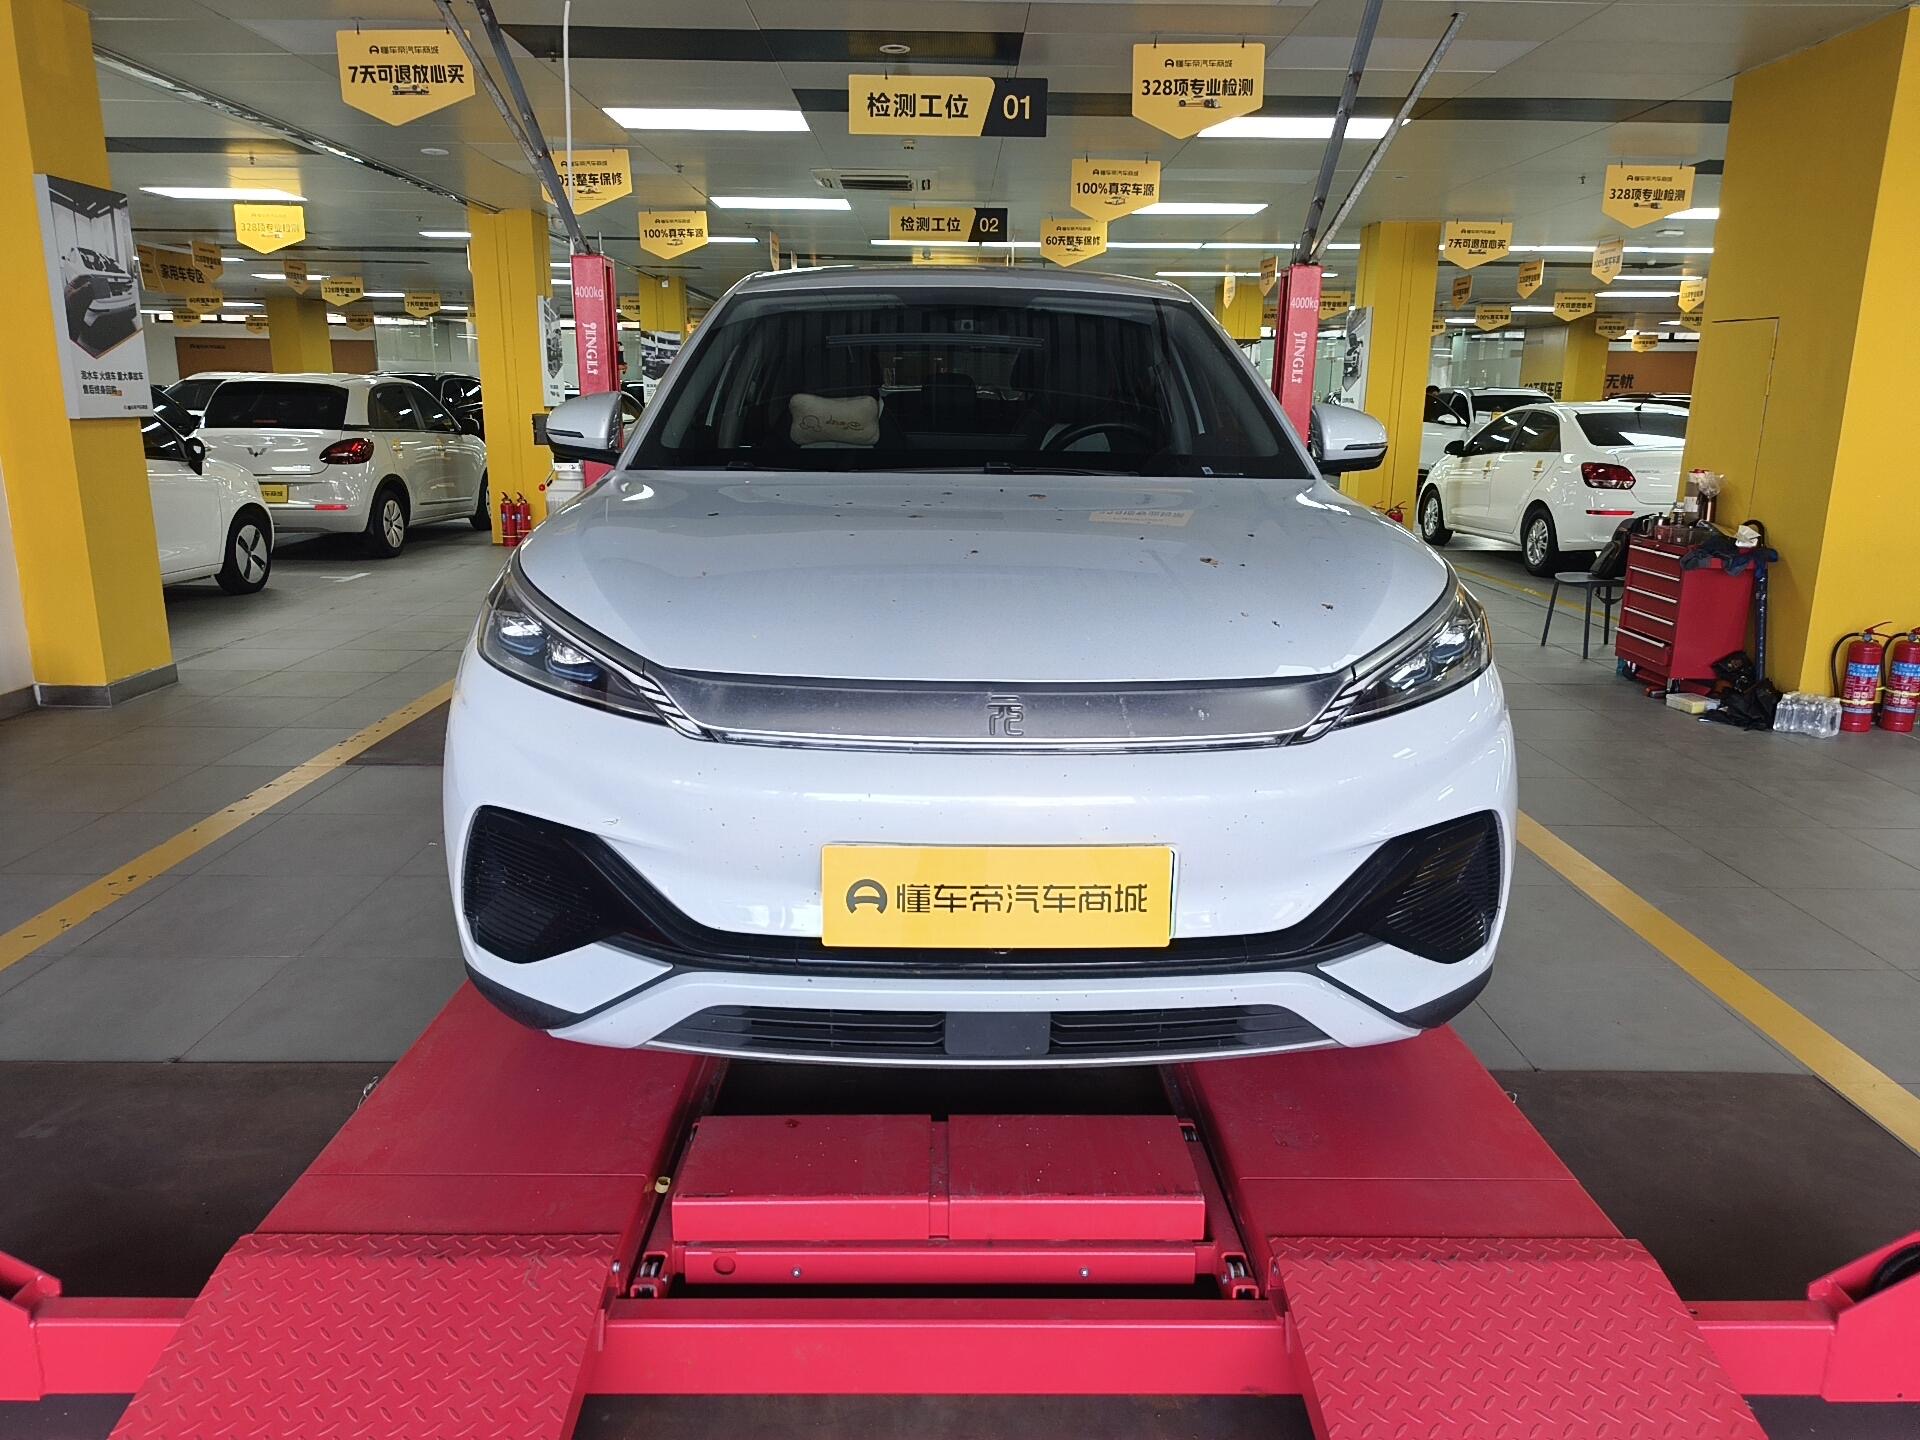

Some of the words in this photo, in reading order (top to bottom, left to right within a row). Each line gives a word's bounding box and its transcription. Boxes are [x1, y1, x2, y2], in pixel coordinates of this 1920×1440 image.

[348, 64, 465, 83] 7天可退放心买
[1141, 78, 1254, 98] 328项专业检测
[867, 92, 969, 119] 检测工位
[1003, 94, 1031, 120] 01
[1076, 182, 1155, 197] 100%真实车源
[1608, 188, 1686, 202] 328项专业检测
[900, 216, 961, 232] 检测工位
[979, 217, 999, 233] 02
[643, 228, 704, 238] 100%真实车源
[1045, 235, 1101, 246] 60天整车保修
[1448, 238, 1506, 249] 7天可退放心买
[160, 263, 206, 284] 家用车专区
[574, 286, 604, 301] 4000kg
[1290, 296, 1320, 312] 4000kg
[896, 883, 1148, 914] 懂车帝汽车商城
